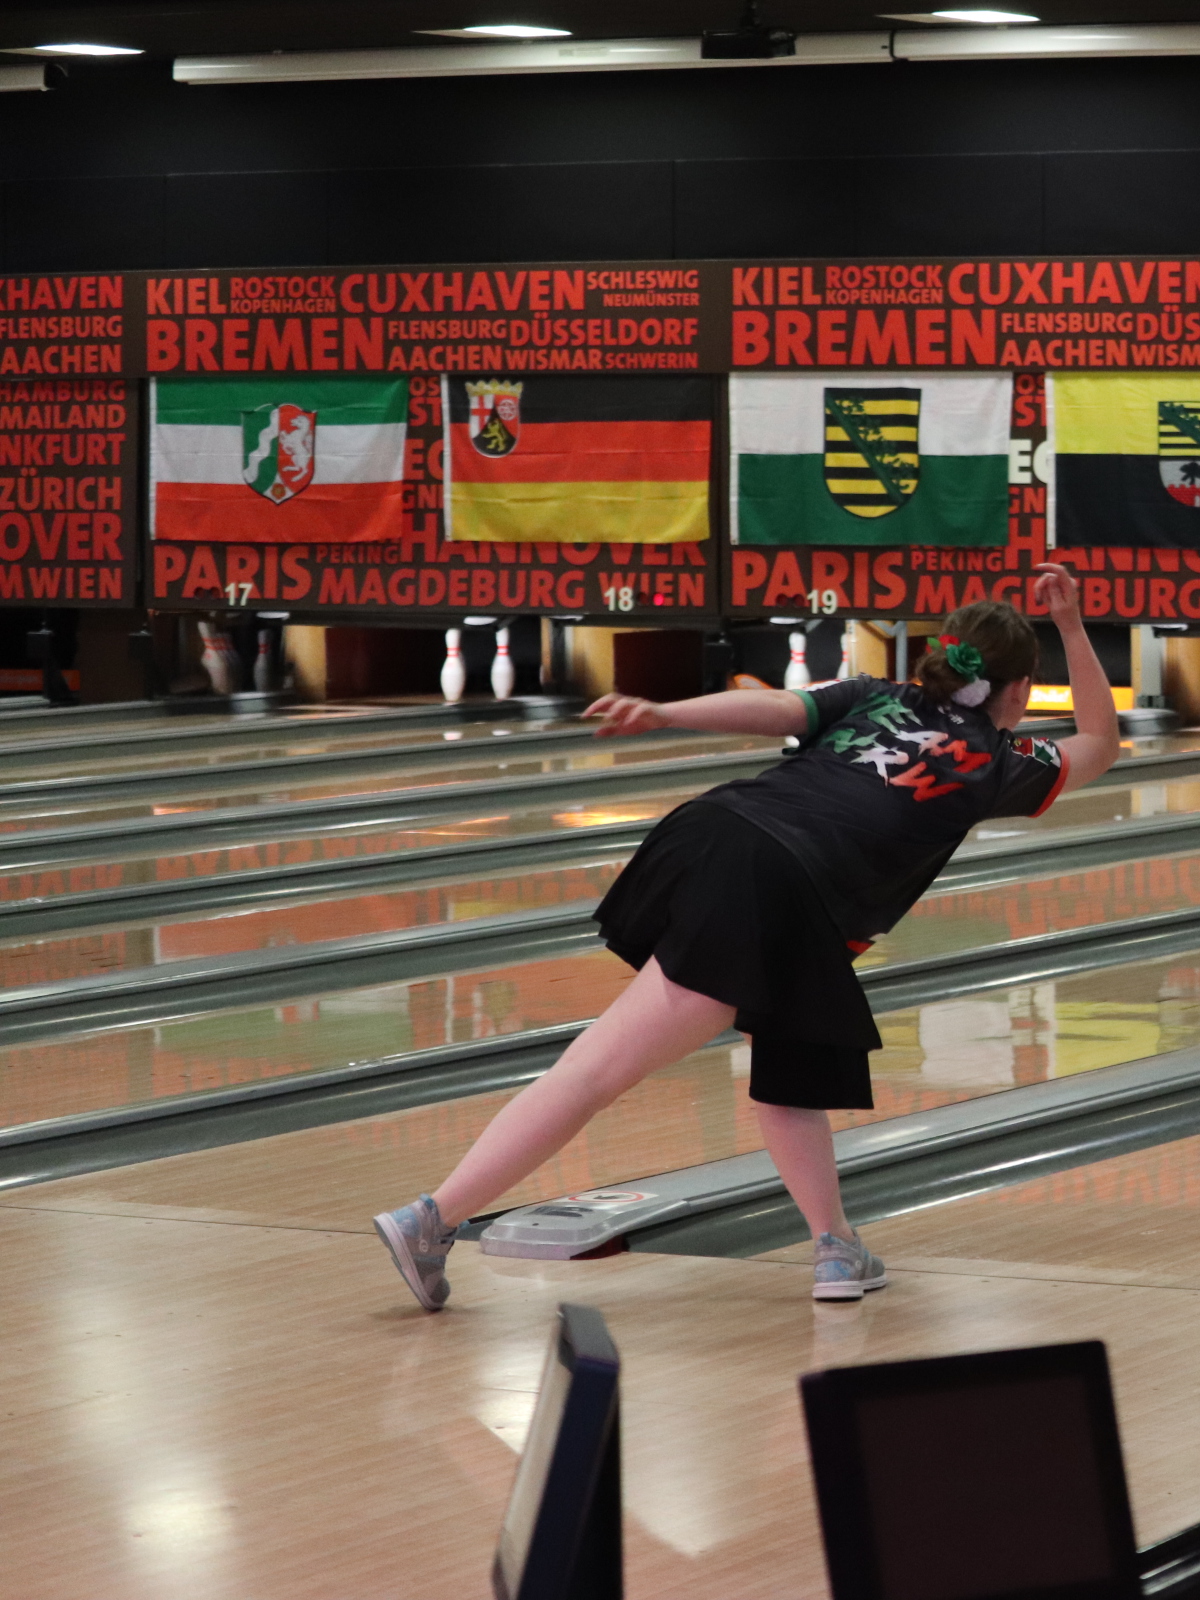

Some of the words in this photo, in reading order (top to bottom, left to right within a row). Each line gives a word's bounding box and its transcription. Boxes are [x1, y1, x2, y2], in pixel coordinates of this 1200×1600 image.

[0, 276, 123, 310] HAVEN
[146, 278, 227, 314] KIEL
[230, 276, 336, 299] ROSTOCK
[340, 270, 585, 313] CUXHAVEN
[587, 270, 699, 290] SCHLESWIG
[230, 298, 337, 314] KOPENHAGEN
[603, 290, 699, 307] NEUMÜNSTER
[732, 267, 822, 306] KIEL
[825, 265, 943, 289] ROSTOCK
[825, 288, 943, 305] KOPENHAGEN
[146, 317, 384, 371] BREMEN
[388, 319, 507, 339] FLENSBURG
[510, 312, 699, 347] DÜSSELDORF
[732, 309, 996, 365] BREMEN
[1001, 312, 1133, 333] FLENSBURG
[1000, 339, 1128, 366] AACHEN
[0, 344, 122, 374] AACHEN
[387, 345, 501, 371] AACHEN
[505, 349, 602, 371] WISMAR
[605, 352, 699, 370] SCHWERIN
[0, 404, 127, 430] MAILAND
[0, 433, 126, 466] NKFURT
[0, 467, 122, 511] ZÜRICH
[0, 512, 124, 561] OVER
[28, 567, 122, 599] WIEN
[153, 545, 312, 600] PARIS
[315, 544, 400, 564] PEKING
[318, 568, 585, 608] MAGDEBURG
[598, 571, 704, 607] WIEN
[731, 551, 907, 610] PARIS
[911, 551, 1003, 572] PEKING
[225, 583, 253, 606] 17
[604, 586, 634, 612] 18
[807, 589, 838, 614] 19
